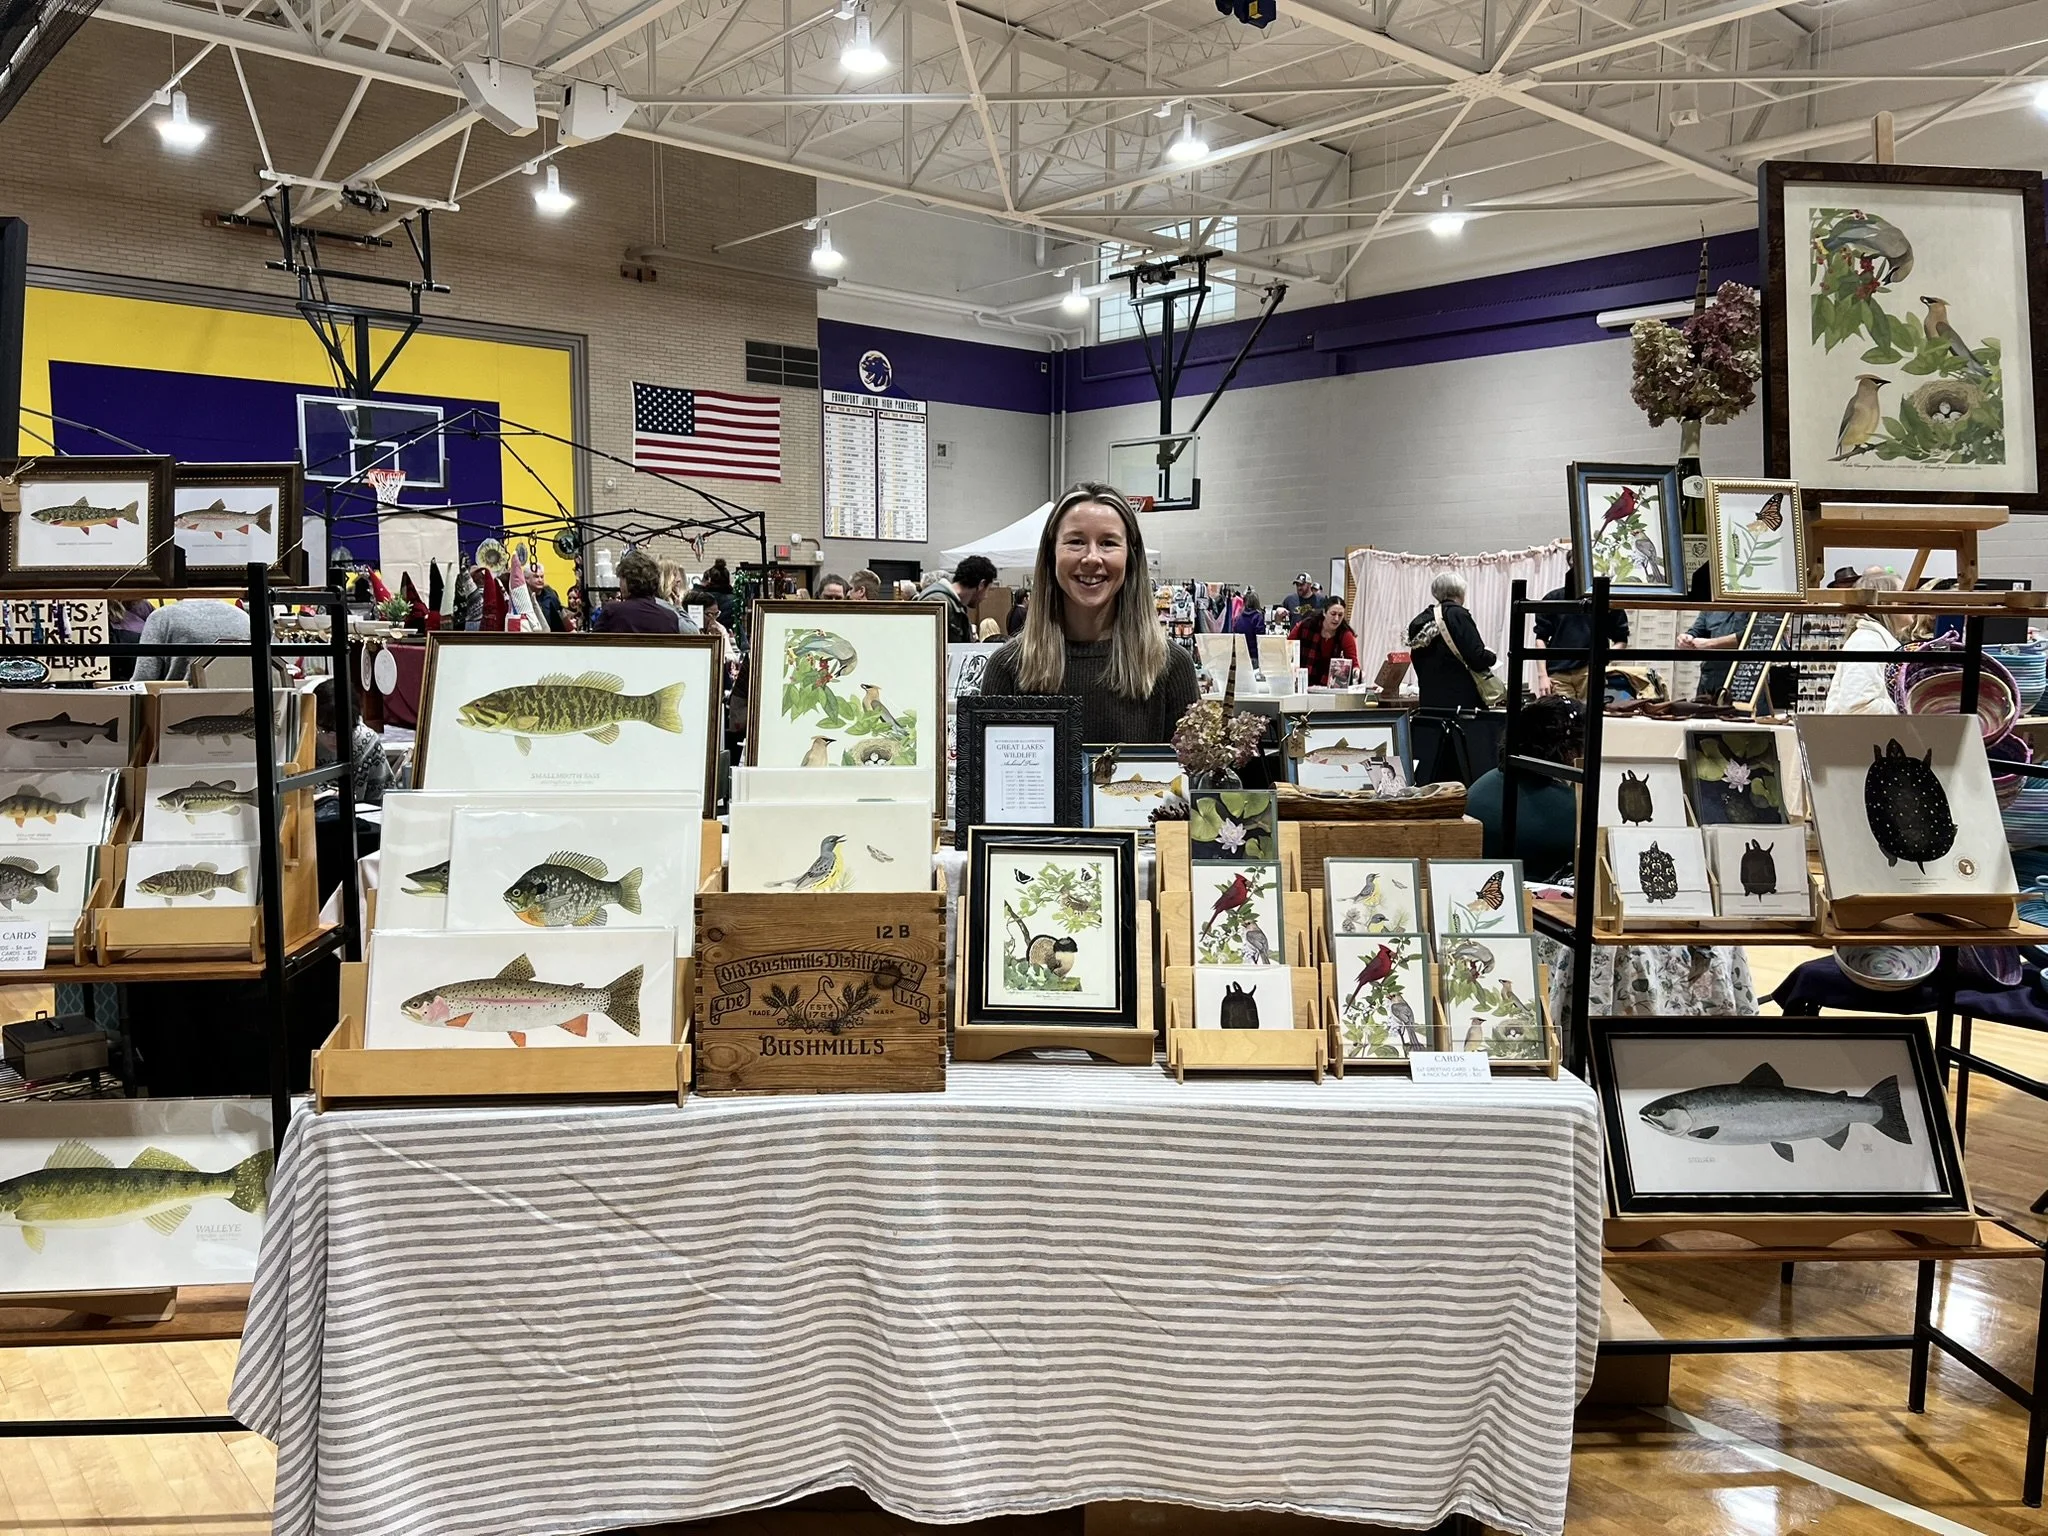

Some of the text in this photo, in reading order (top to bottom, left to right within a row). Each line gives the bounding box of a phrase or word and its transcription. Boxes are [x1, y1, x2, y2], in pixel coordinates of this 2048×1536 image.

[832, 393, 919, 412] FRANKFORT JUNIOR HIGH PANTHERS
[10, 603, 88, 624] RITS
[2, 931, 37, 941] CARDS
[876, 925, 910, 939] 12 B
[748, 952, 823, 976] Bushmills
[721, 964, 746, 982] Old
[714, 994, 745, 1010] The
[809, 1011, 835, 1019] 1784
[759, 1035, 885, 1057] BUSHMILLS
[195, 1223, 242, 1233] WALLEYE
